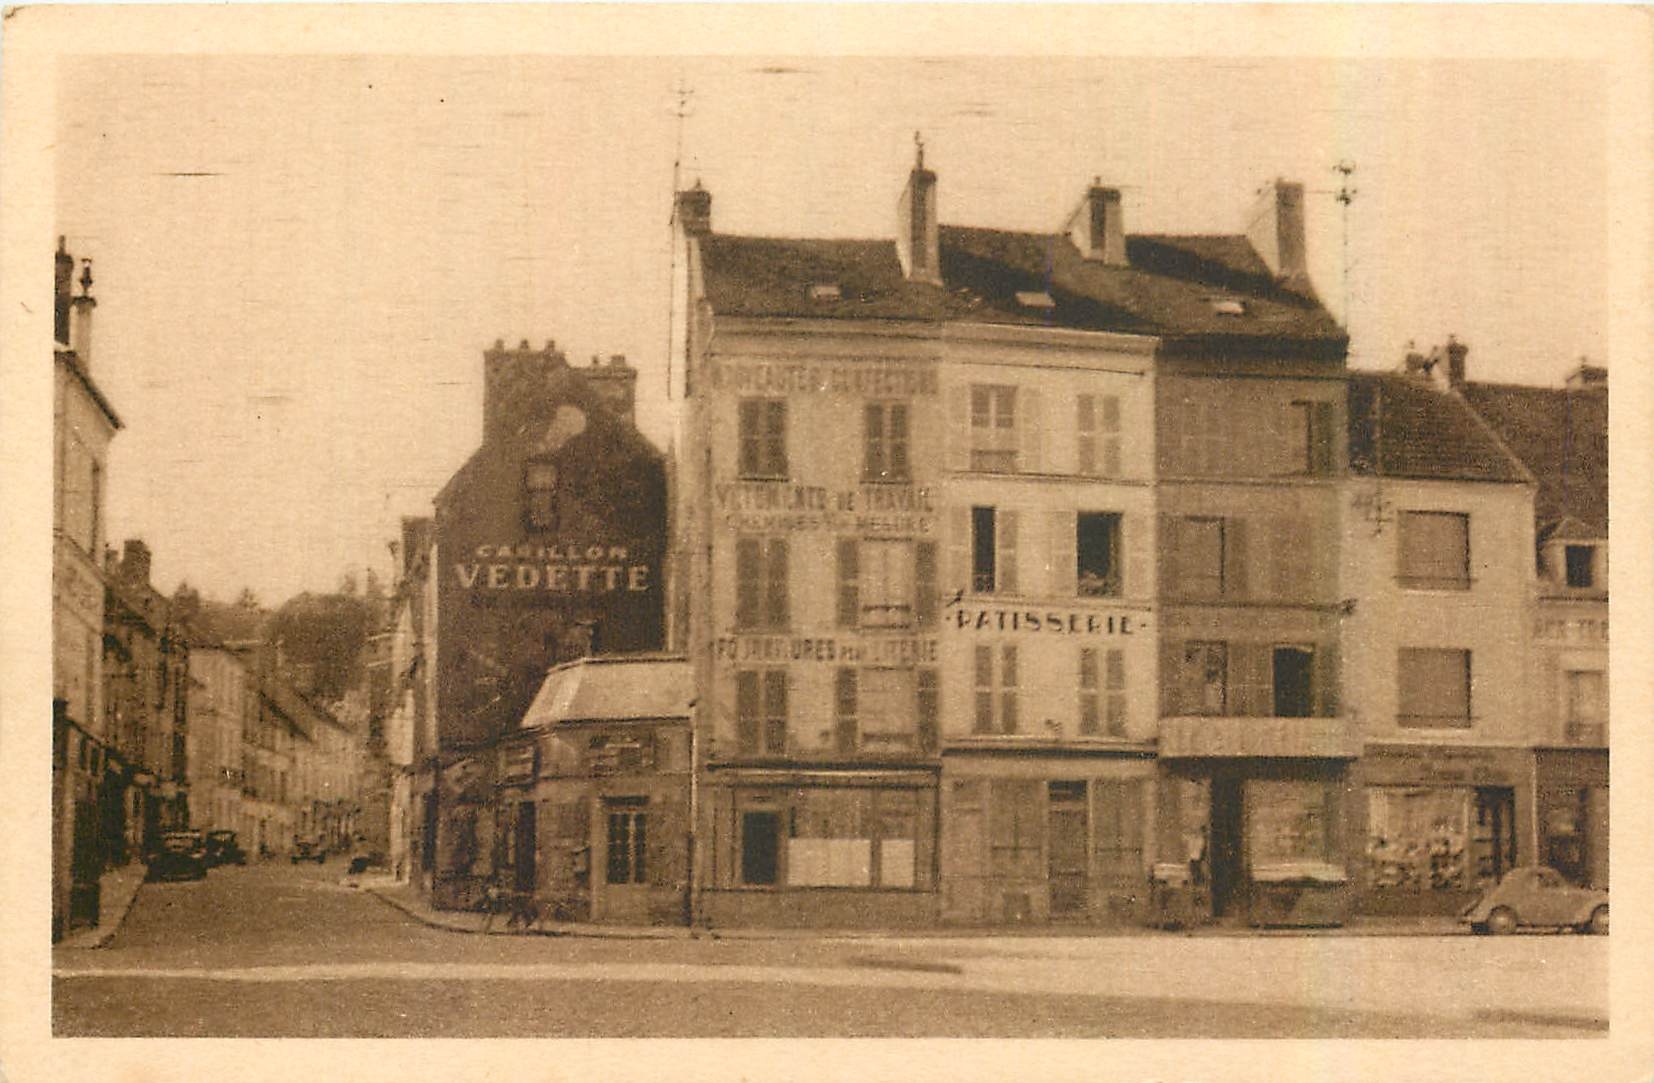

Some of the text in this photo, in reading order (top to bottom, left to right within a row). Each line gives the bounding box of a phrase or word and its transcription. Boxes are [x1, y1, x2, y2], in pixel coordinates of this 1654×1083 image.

[475, 543, 629, 560] CARILLON
[455, 563, 651, 592] VEDETTE
[957, 609, 1133, 634] PATISSERIE
